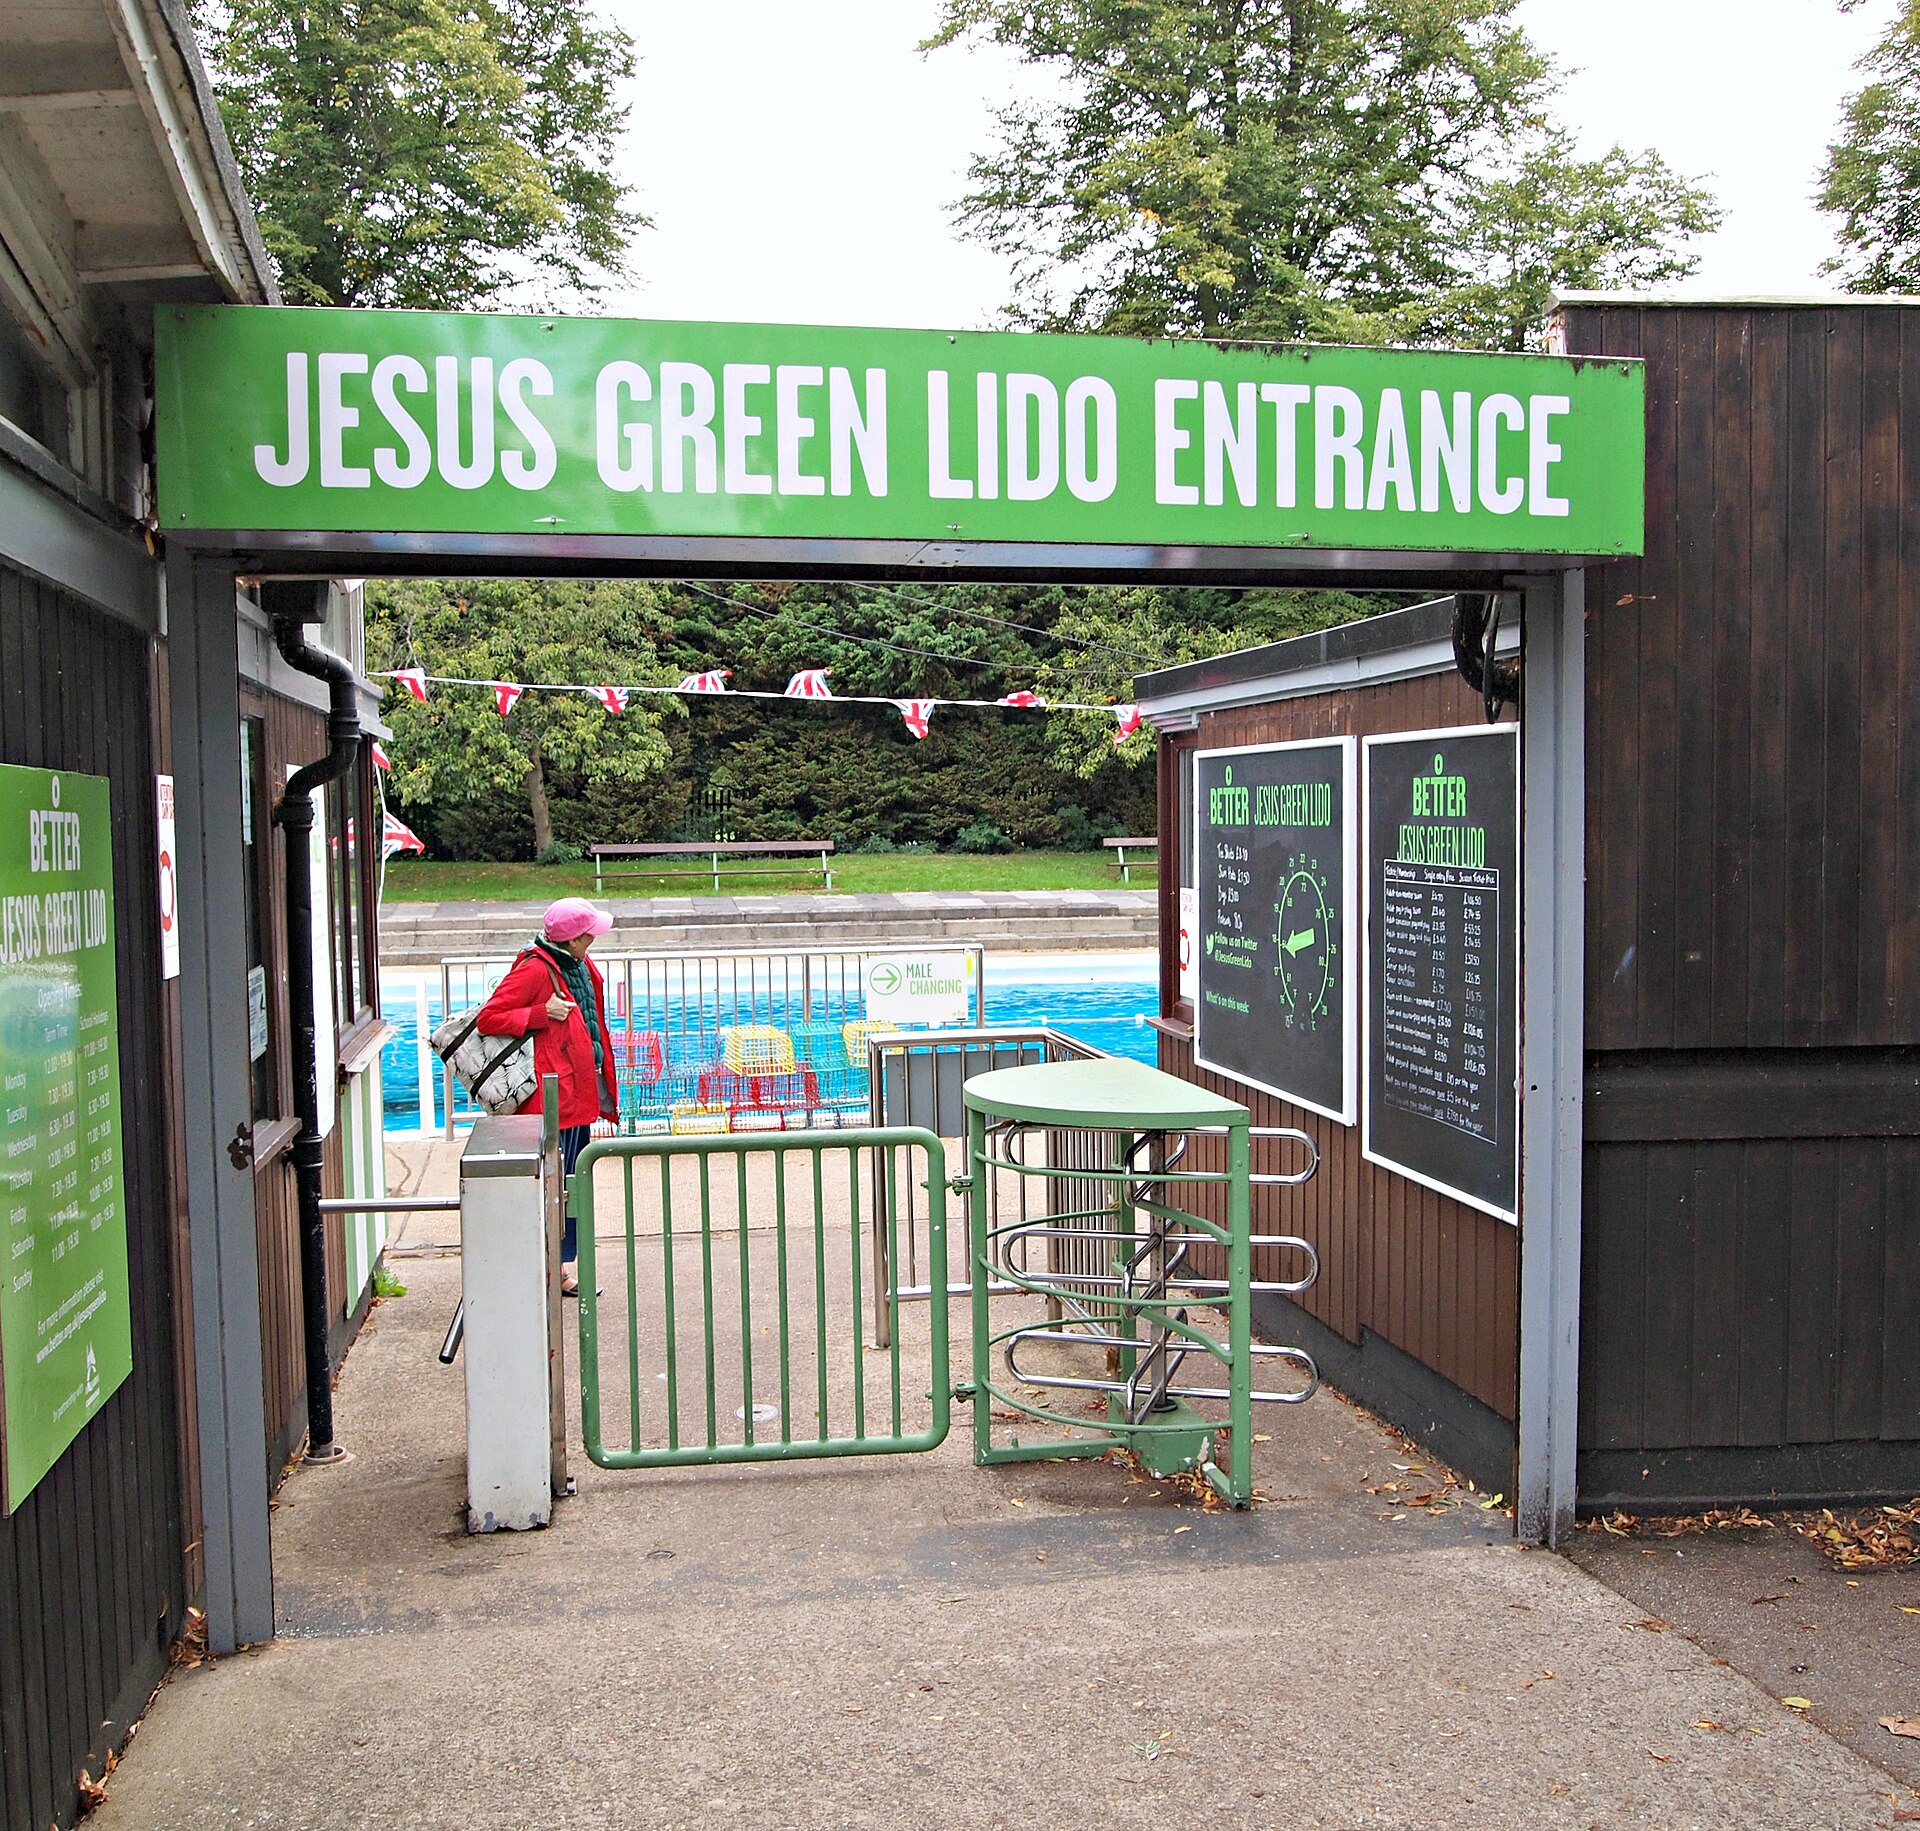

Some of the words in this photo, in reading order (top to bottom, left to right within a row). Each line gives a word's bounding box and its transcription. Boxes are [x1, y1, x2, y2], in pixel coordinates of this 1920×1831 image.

[255, 352, 557, 491] JESUS
[596, 360, 888, 497] GREEN
[927, 369, 1118, 502] LIDO
[1154, 378, 1570, 517] ENTRANCE
[1210, 786, 1249, 826] BETTER
[1254, 785, 1279, 826] JESUS
[1280, 784, 1308, 826] GREEN
[1310, 783, 1331, 826] LIDO
[1412, 776, 1467, 816] BETTER
[30, 809, 80, 872] BETTER
[1396, 824, 1425, 863] JESUS
[1427, 826, 1459, 867] GREEN
[1462, 827, 1485, 868] LIDO
[0, 894, 40, 964] JESUS
[44, 890, 82, 956] GREEN
[84, 888, 106, 948] LIDO
[1215, 932, 1228, 945] Follow
[1229, 938, 1234, 946] us
[1235, 938, 1240, 947] on
[1241, 936, 1258, 950] Twitter
[906, 963, 932, 978] MALE
[38, 984, 63, 1012] Opening
[910, 979, 962, 995] CHANGING
[44, 1028, 56, 1042] Term
[57, 1024, 67, 1036] Time
[5, 1074, 26, 1090] Monday
[6, 1105, 27, 1124] Tuesday
[7, 1134, 36, 1157] Wednesday
[9, 1170, 32, 1190] Thursday
[10, 1206, 26, 1225] Friday
[12, 1235, 34, 1259] Saturday
[13, 1270, 32, 1292] Sunday
